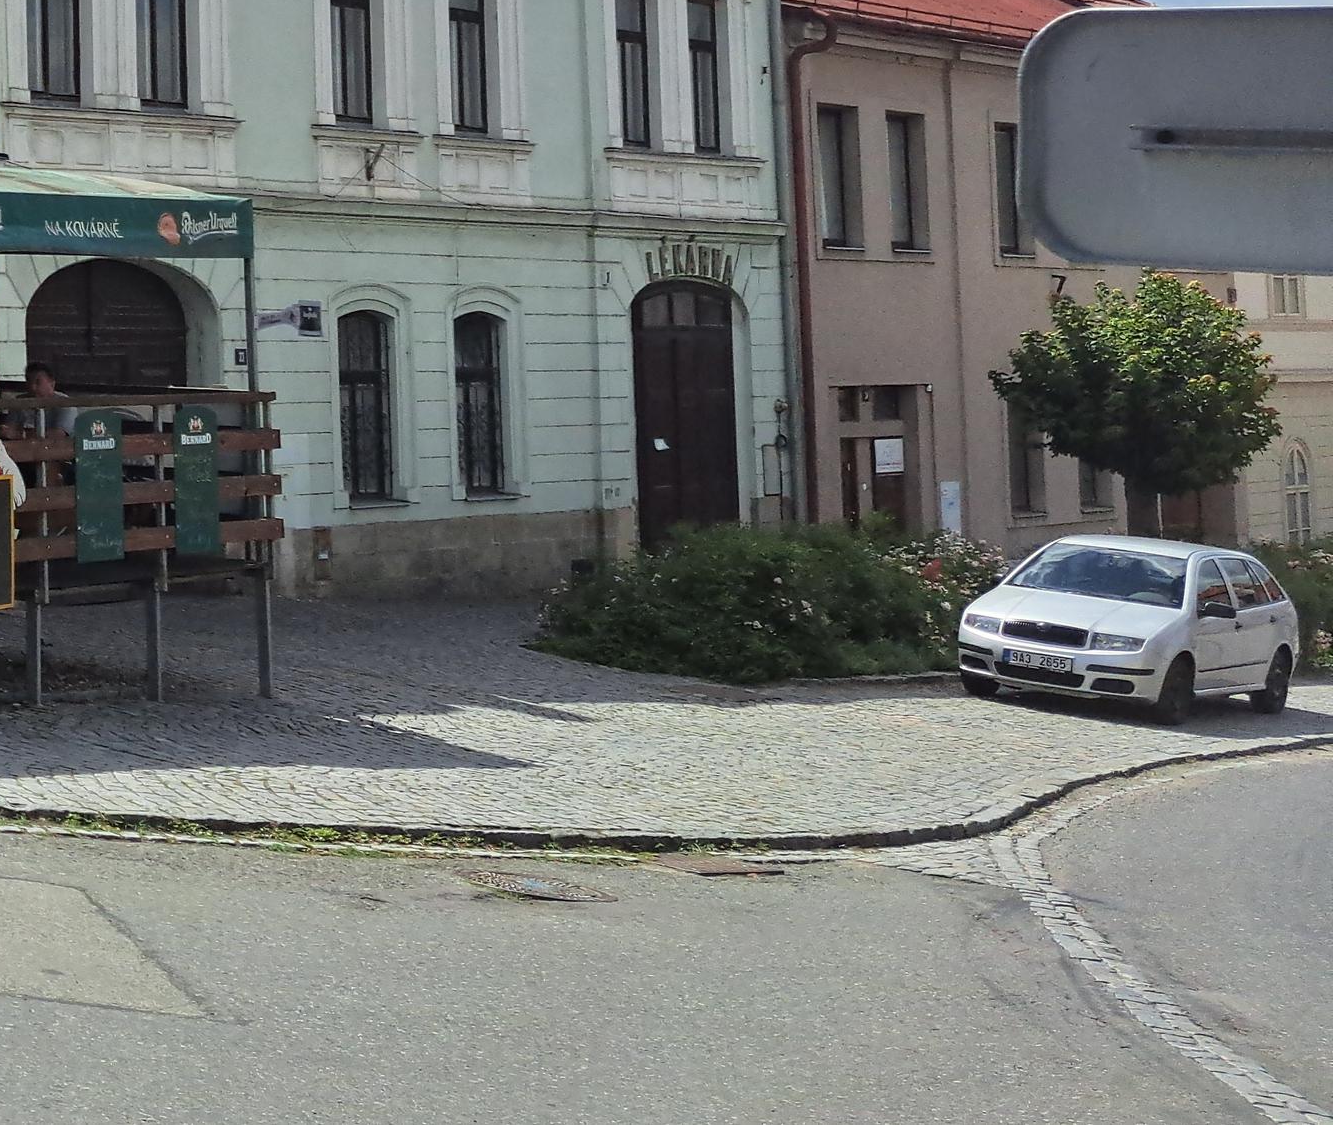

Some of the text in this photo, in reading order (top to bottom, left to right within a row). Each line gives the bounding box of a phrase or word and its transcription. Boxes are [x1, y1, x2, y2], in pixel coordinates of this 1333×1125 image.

[44, 218, 125, 239] NA KOVÁRNĚ
[645, 235, 734, 288] LÉKÁRNA
[83, 437, 115, 451] BERNARD
[181, 432, 211, 445] BERNARD
[1012, 652, 1067, 669] 9A3 2655
